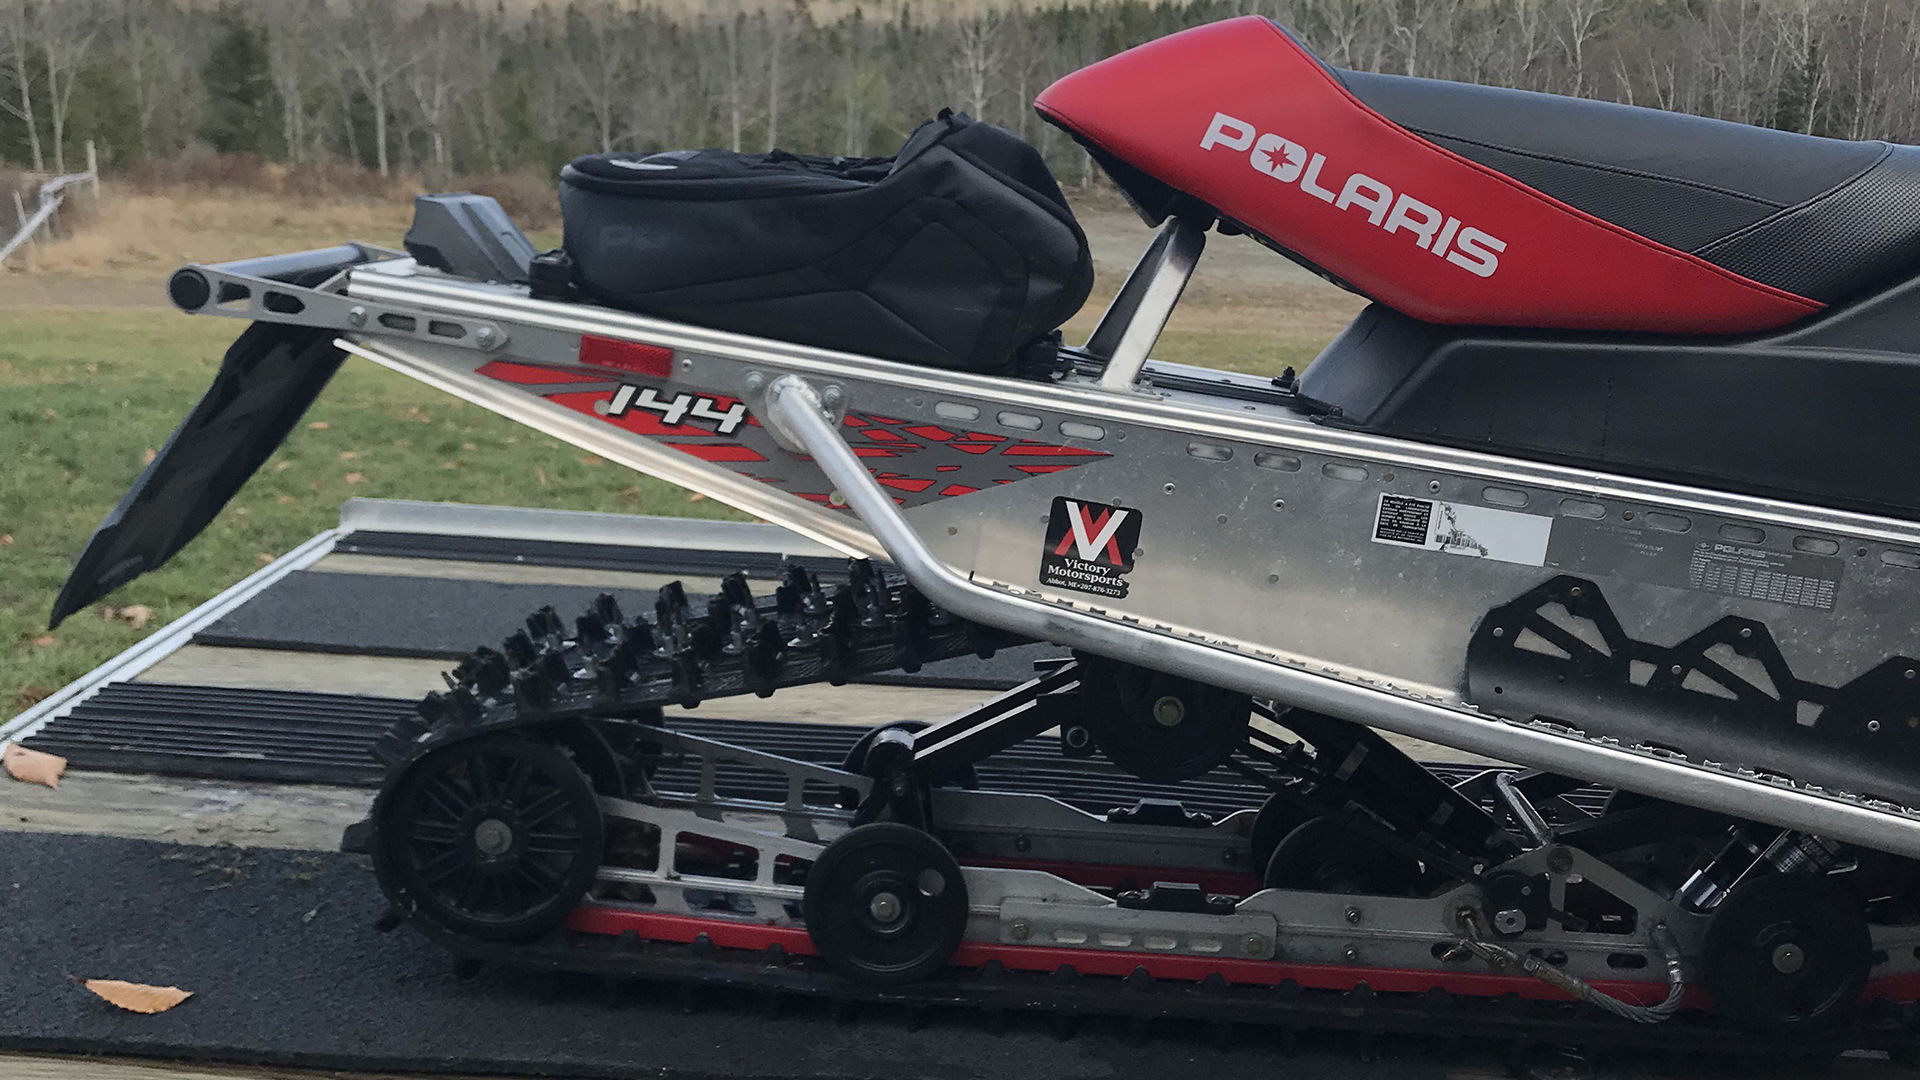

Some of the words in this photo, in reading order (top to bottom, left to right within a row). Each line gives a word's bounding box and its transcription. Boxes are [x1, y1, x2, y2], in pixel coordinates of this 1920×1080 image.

[1199, 111, 1508, 278] POLARIS
[607, 383, 747, 436] 144
[1047, 565, 1123, 587] Motorsports
[1064, 558, 1111, 576] Victory
